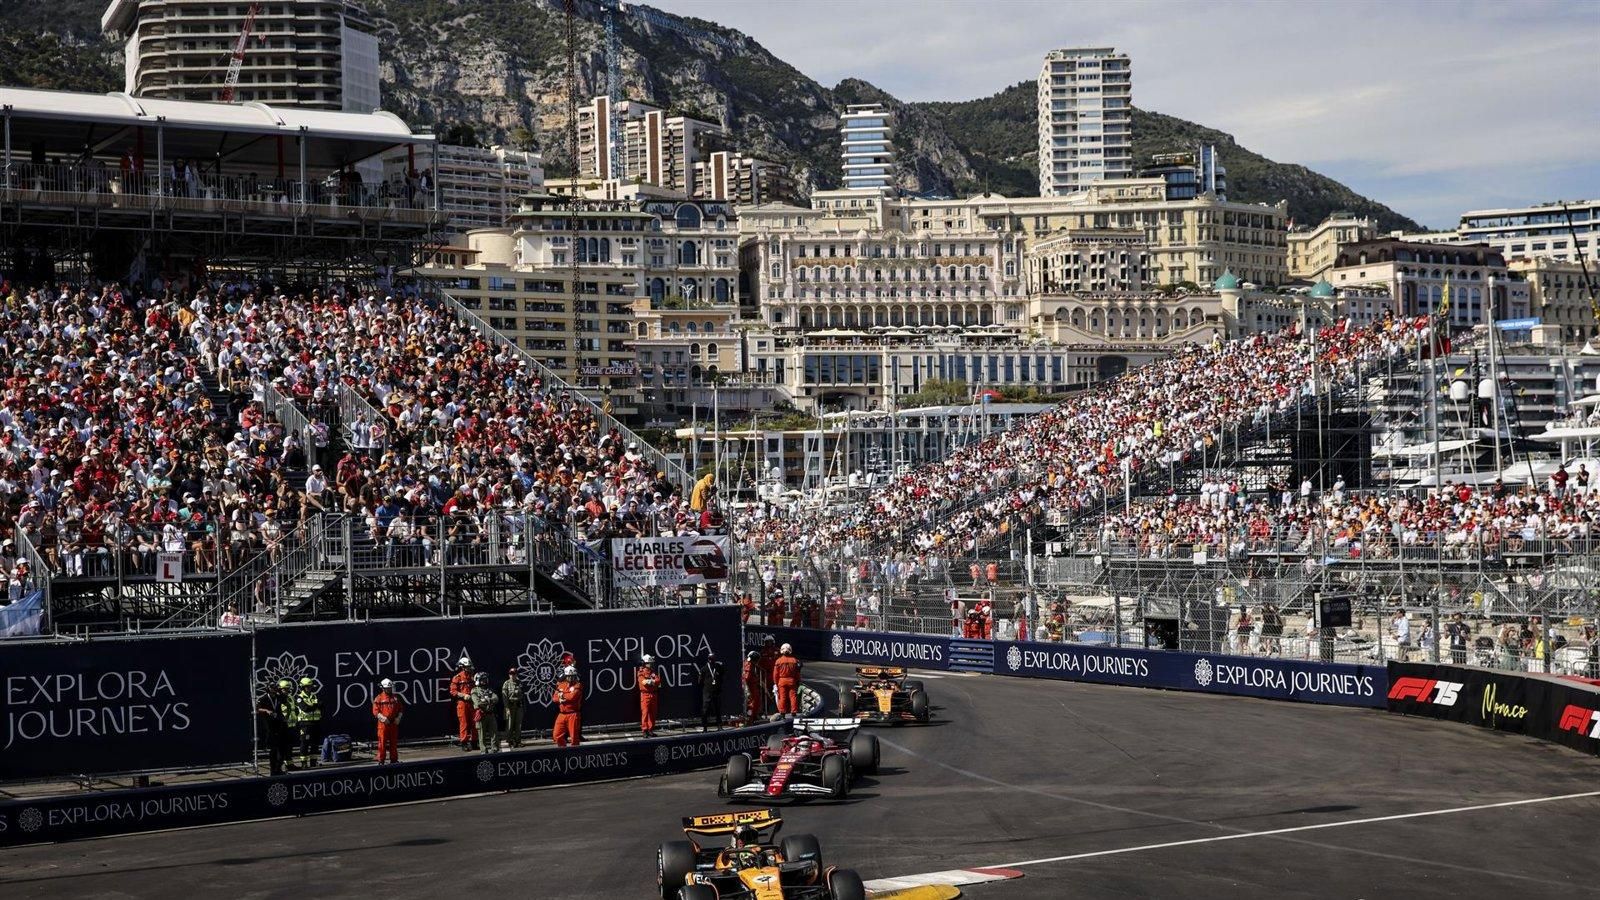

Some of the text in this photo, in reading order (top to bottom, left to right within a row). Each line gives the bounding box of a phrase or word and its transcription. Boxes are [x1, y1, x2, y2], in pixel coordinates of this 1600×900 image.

[625, 541, 684, 555] CHARLES
[163, 563, 175, 579] L
[615, 554, 683, 571] LECLERC
[845, 638, 942, 661] EXPLORA JOURNEYS
[1024, 651, 1149, 677] EXPLORA JOURNEYS
[7, 669, 176, 705] EXPLORA
[1216, 664, 1374, 697] EXPLORA JOURNEYS
[1481, 683, 1528, 719] Monaco
[4, 702, 191, 749] JOURNEYS
[671, 734, 767, 760] EXPLORA JOURNEYS
[498, 751, 628, 777] EXPLORA JOURNEYS
[292, 770, 444, 800] EXPLORA JOURNEYS
[49, 792, 228, 826] EXPLORA JOURNEYS
